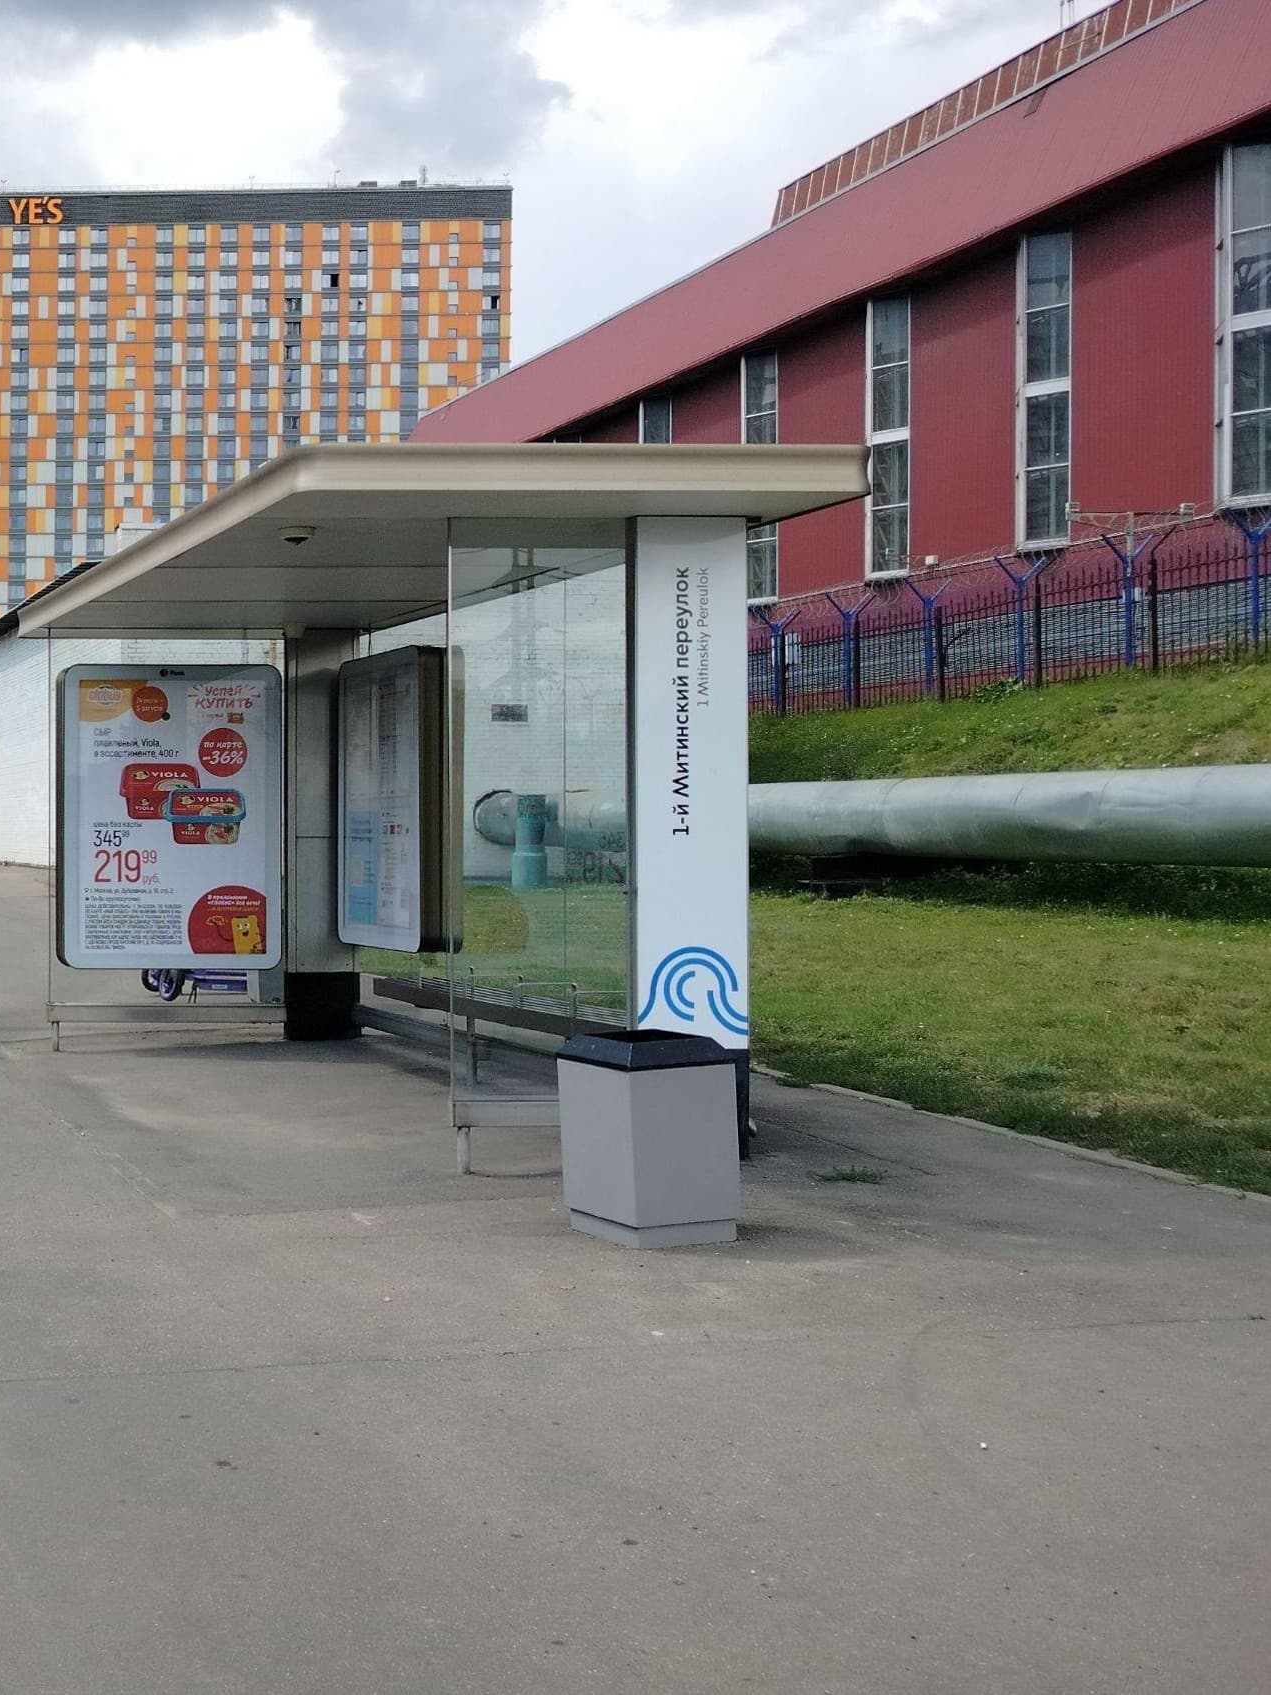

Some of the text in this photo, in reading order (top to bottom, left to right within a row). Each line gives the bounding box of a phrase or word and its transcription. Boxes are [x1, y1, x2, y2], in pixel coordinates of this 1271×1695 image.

[8, 196, 63, 224] YE'S
[697, 567, 712, 708] 1 Mitinskiy Pereulok
[195, 698, 253, 710] КУПИТЬ
[672, 567, 693, 836] 1-й Митинский переулок
[141, 738, 162, 748] Viola,
[216, 741, 243, 750] карте
[159, 749, 174, 758] 400
[202, 750, 244, 765] -36%
[93, 829, 122, 847] 345
[94, 849, 157, 883] 219 99
[142, 874, 161, 886] руб.
